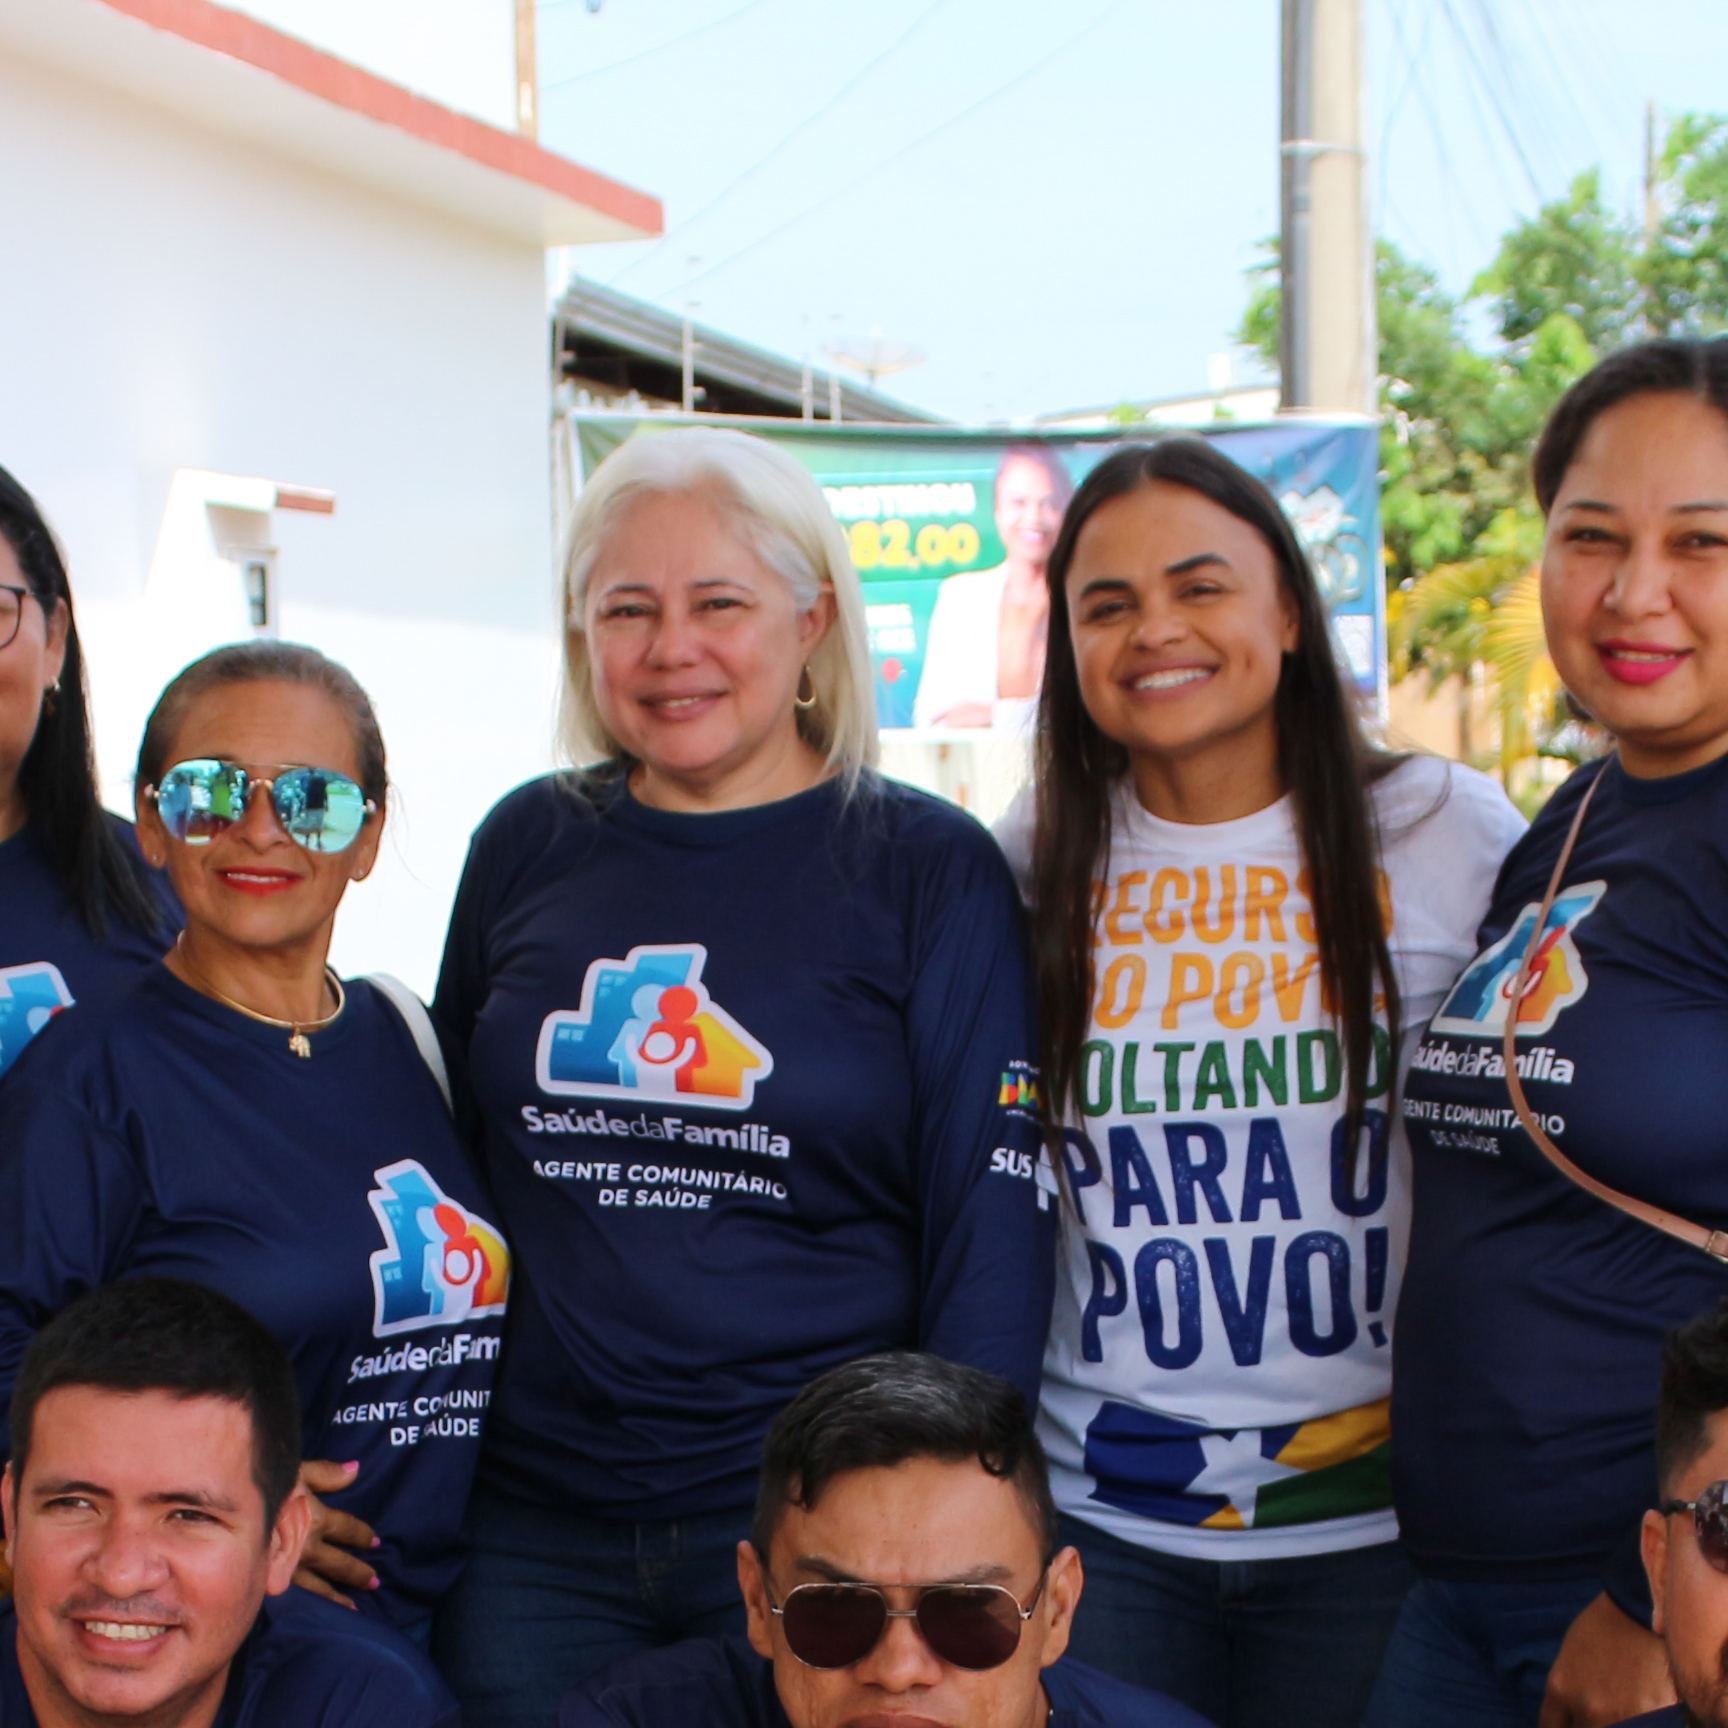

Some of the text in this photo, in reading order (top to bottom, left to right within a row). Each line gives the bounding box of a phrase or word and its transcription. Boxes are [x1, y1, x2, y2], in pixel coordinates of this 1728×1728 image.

[841, 518, 980, 572] 82,00
[533, 1160, 788, 1200] AGENTE COMUNITÁRIO
[990, 1147, 1033, 1179] SUS
[598, 1186, 713, 1209] DE SAÚDE
[1081, 1226, 1390, 1370] POVO!
[390, 1425, 420, 1446] DE
